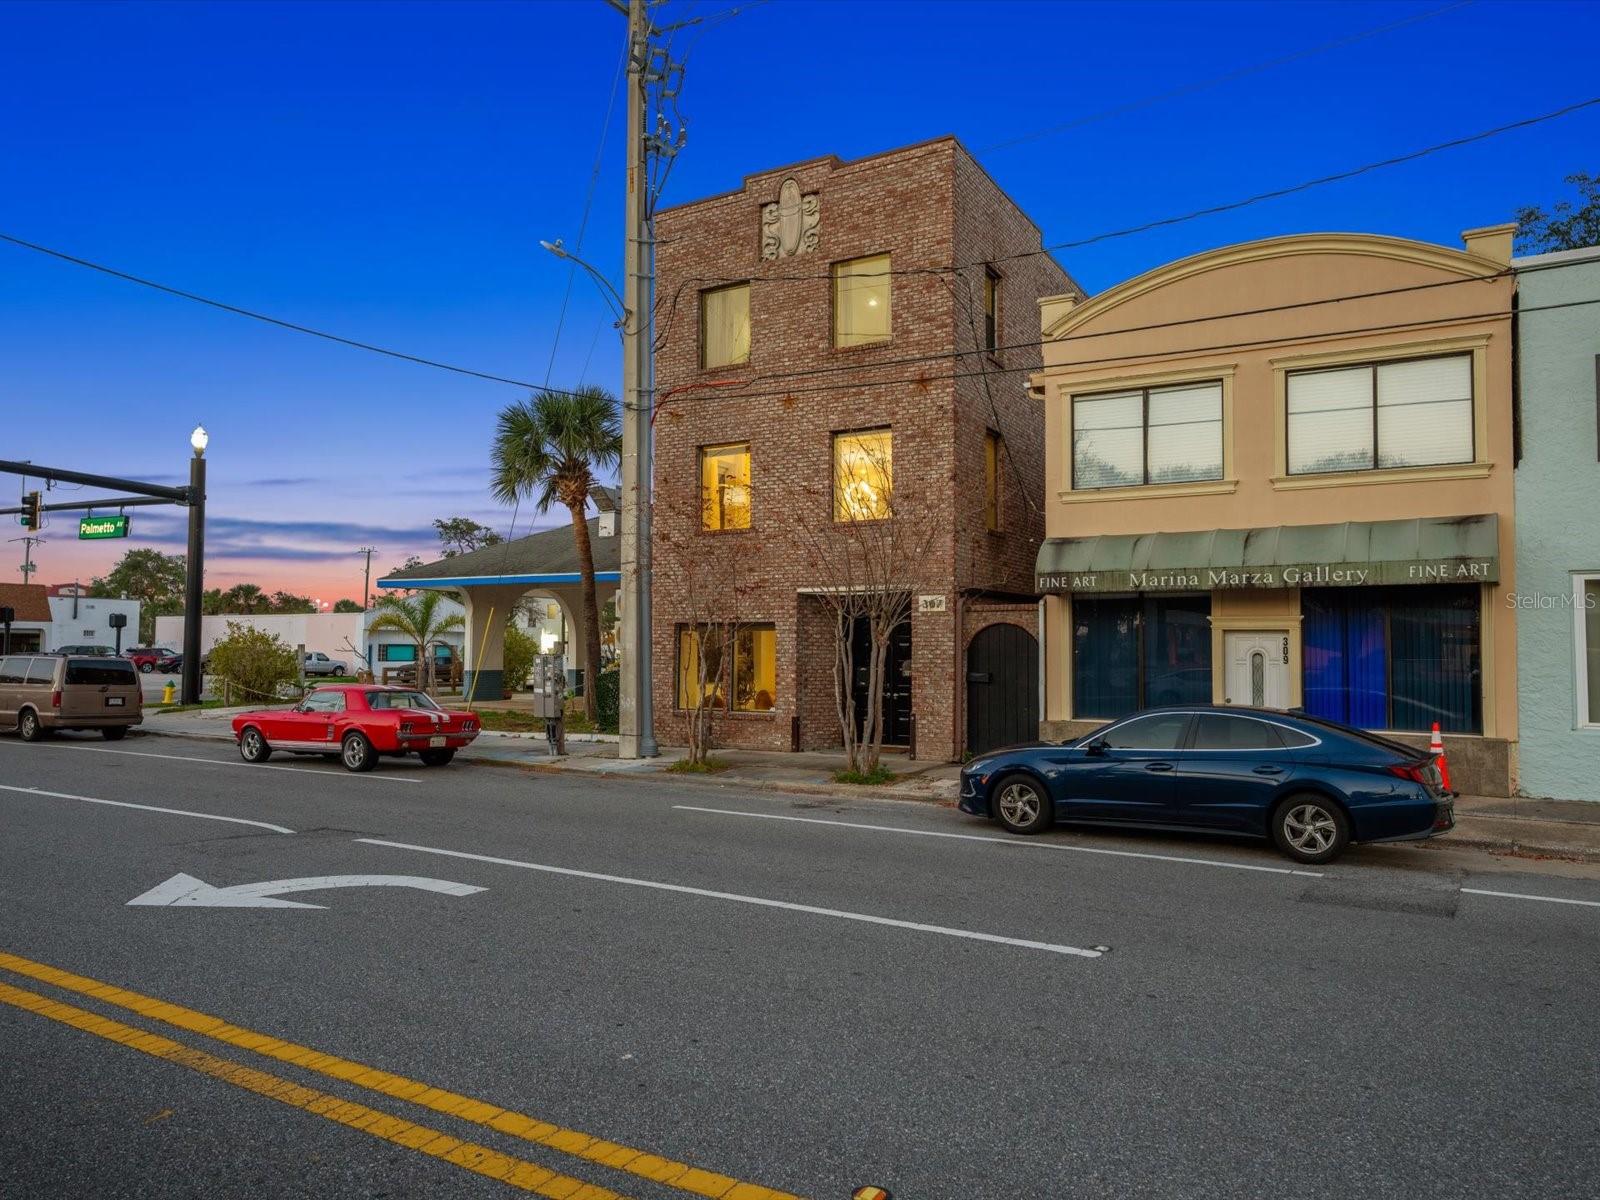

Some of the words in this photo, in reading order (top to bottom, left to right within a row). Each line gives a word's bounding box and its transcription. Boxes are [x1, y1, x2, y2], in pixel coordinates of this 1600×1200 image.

[80, 522, 115, 534] Palmetto
[1129, 571, 1199, 587] Marina
[1208, 569, 1273, 586] Marza
[1283, 566, 1369, 585] Gallery
[1409, 564, 1448, 578] FINE
[1456, 563, 1490, 577] ART
[1039, 576, 1068, 588] FINE
[1073, 576, 1097, 587] ART
